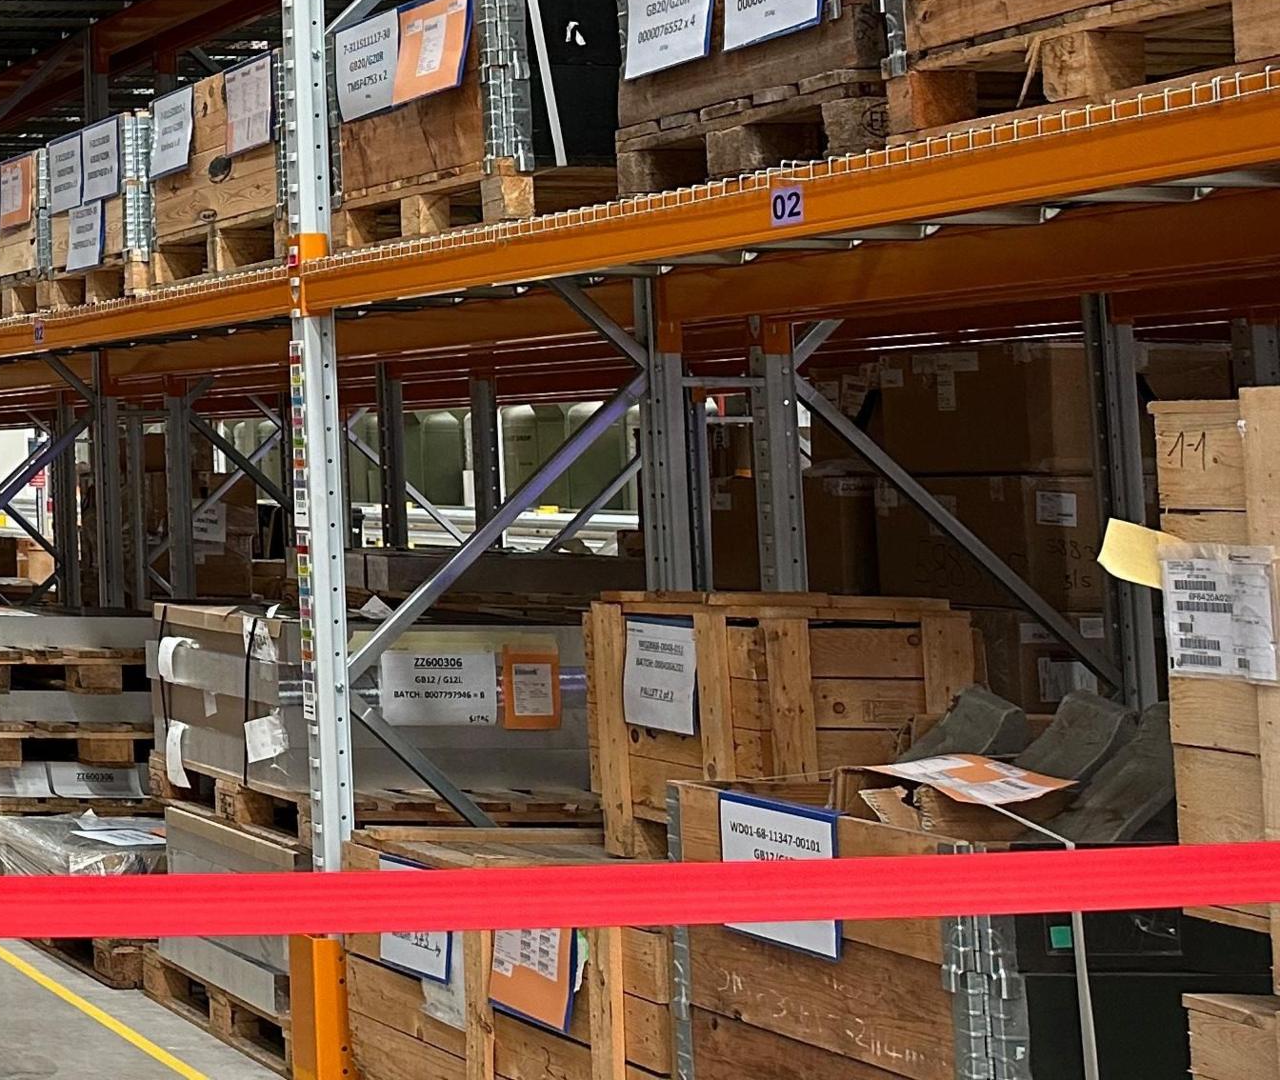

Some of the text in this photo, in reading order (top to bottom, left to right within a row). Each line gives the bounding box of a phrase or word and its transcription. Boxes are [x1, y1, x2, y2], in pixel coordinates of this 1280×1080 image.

[772, 191, 801, 220] 02
[414, 657, 463, 668] ZZ600306
[414, 676, 435, 684] GB12
[729, 820, 821, 853] WD01-68-11347-00101
